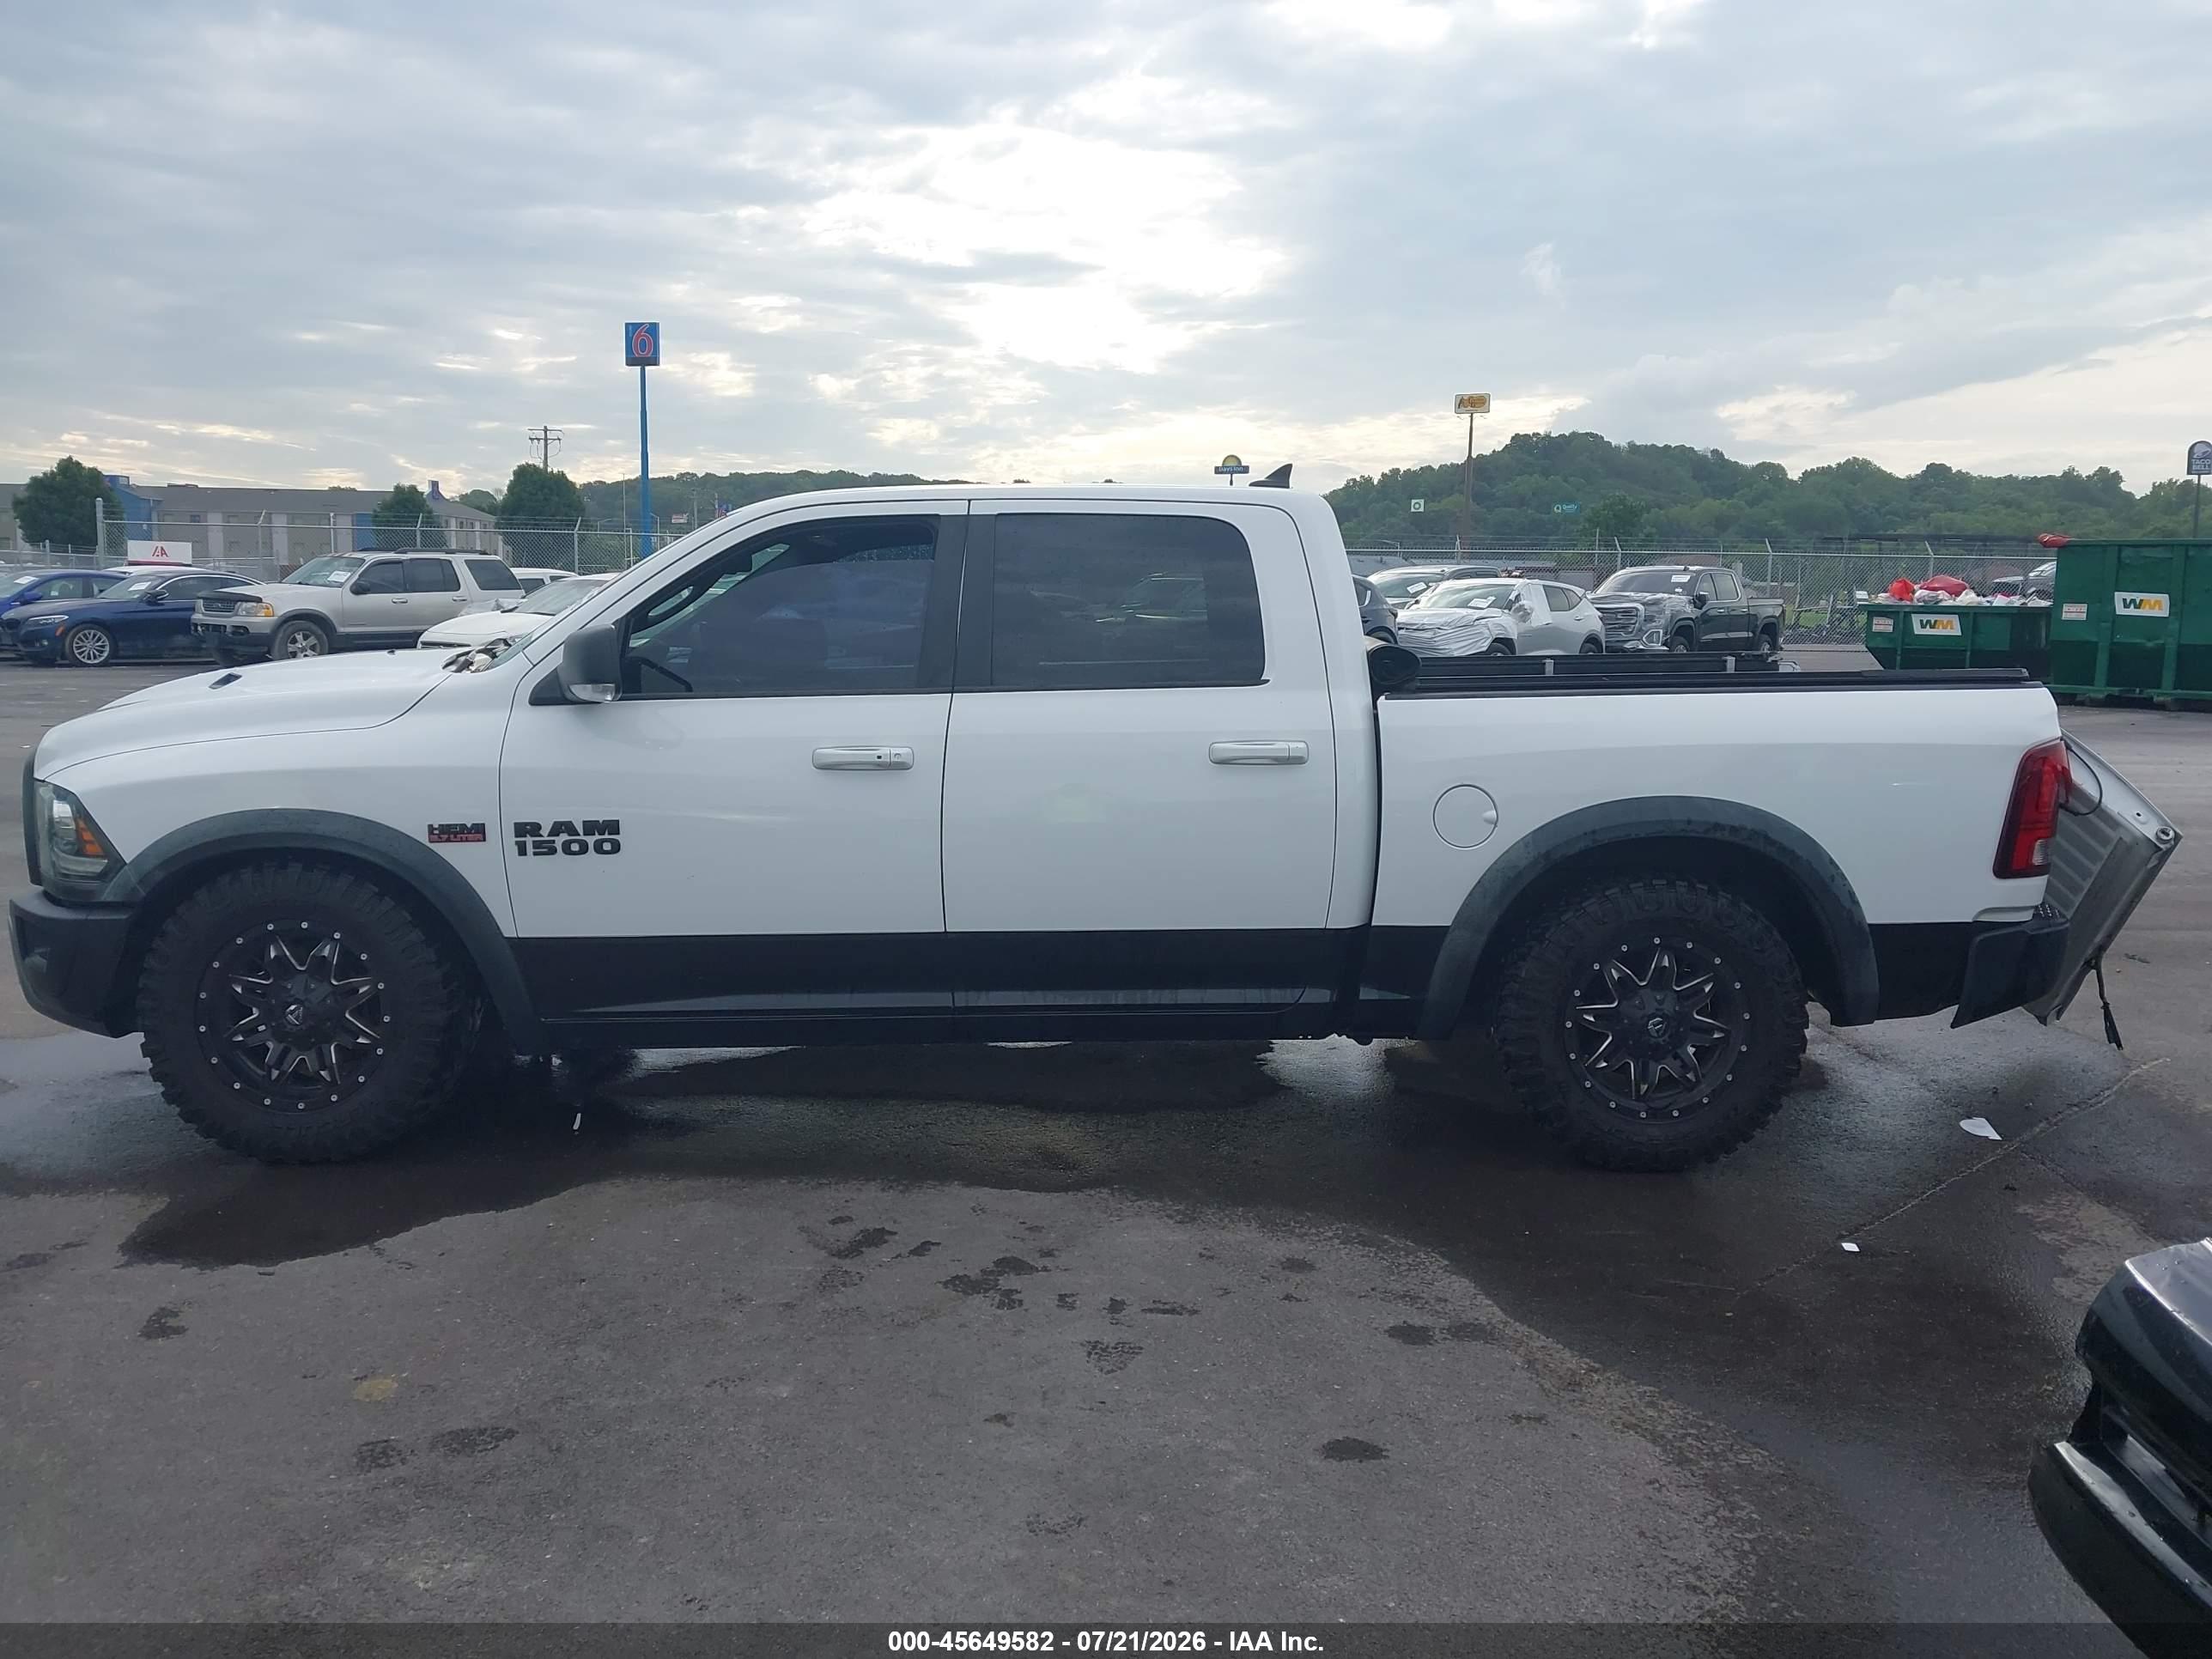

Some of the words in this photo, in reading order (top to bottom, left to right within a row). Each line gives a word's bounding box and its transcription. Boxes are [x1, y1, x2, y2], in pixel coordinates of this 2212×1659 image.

[632, 323, 653, 357] 6
[2122, 598, 2164, 611] WM
[1919, 618, 1954, 629] WM
[428, 823, 485, 834] HEMI
[514, 819, 620, 838] RAM
[515, 837, 621, 857] 1500
